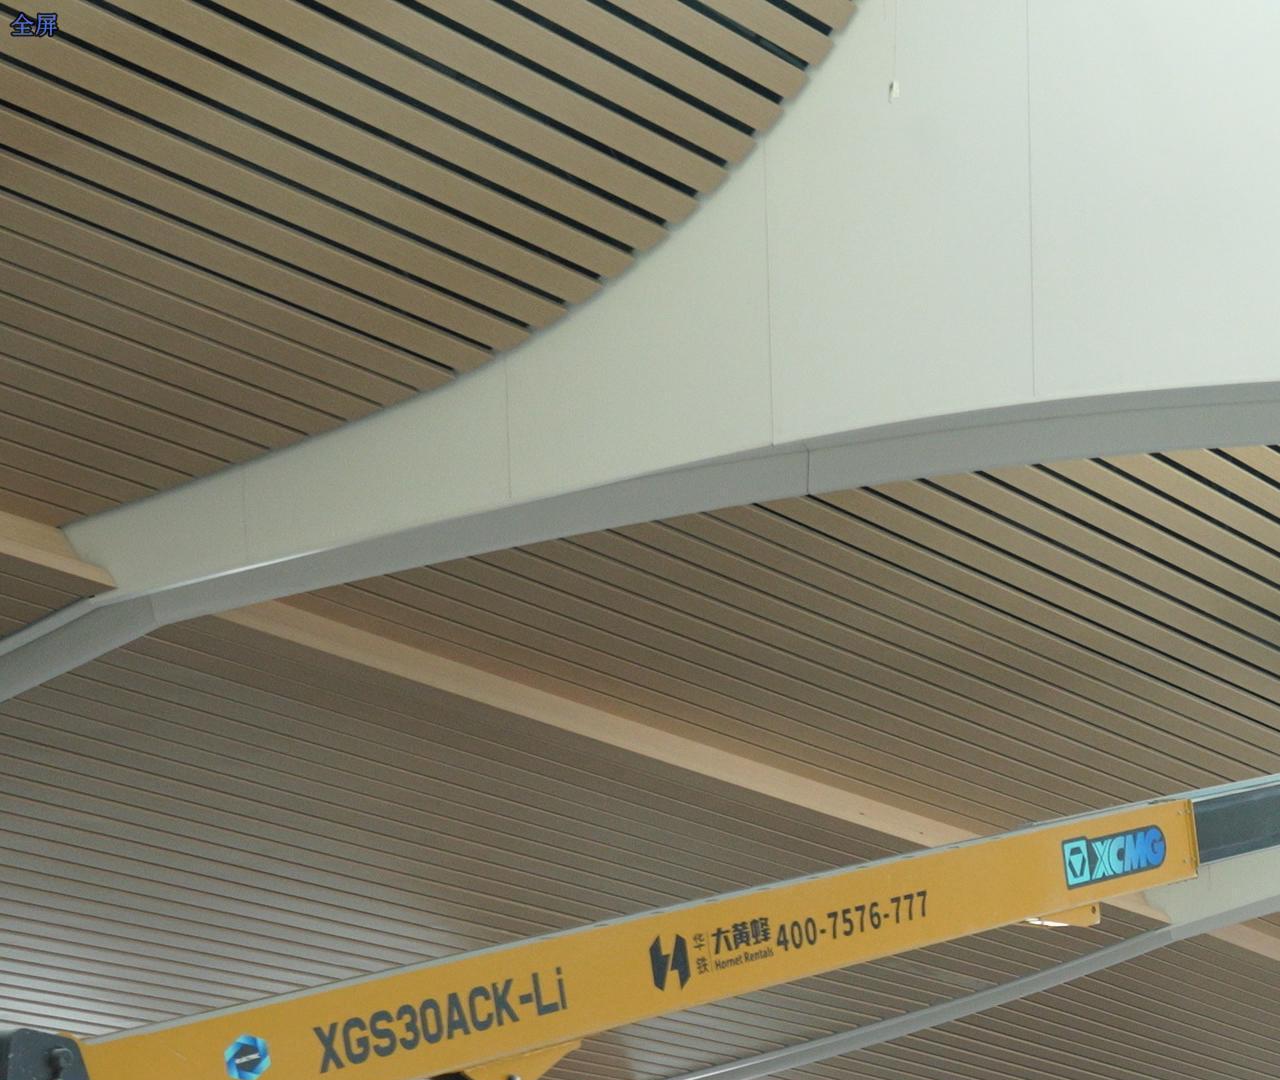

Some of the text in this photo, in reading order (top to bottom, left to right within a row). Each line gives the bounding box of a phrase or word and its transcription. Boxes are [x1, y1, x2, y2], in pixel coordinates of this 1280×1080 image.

[1091, 826, 1166, 880] XCMG
[711, 917, 771, 955] 大黄蜂
[776, 890, 929, 951] 400-7576-777
[714, 954, 743, 970] Hornet
[313, 966, 568, 1073] XGS30ACK-Li
